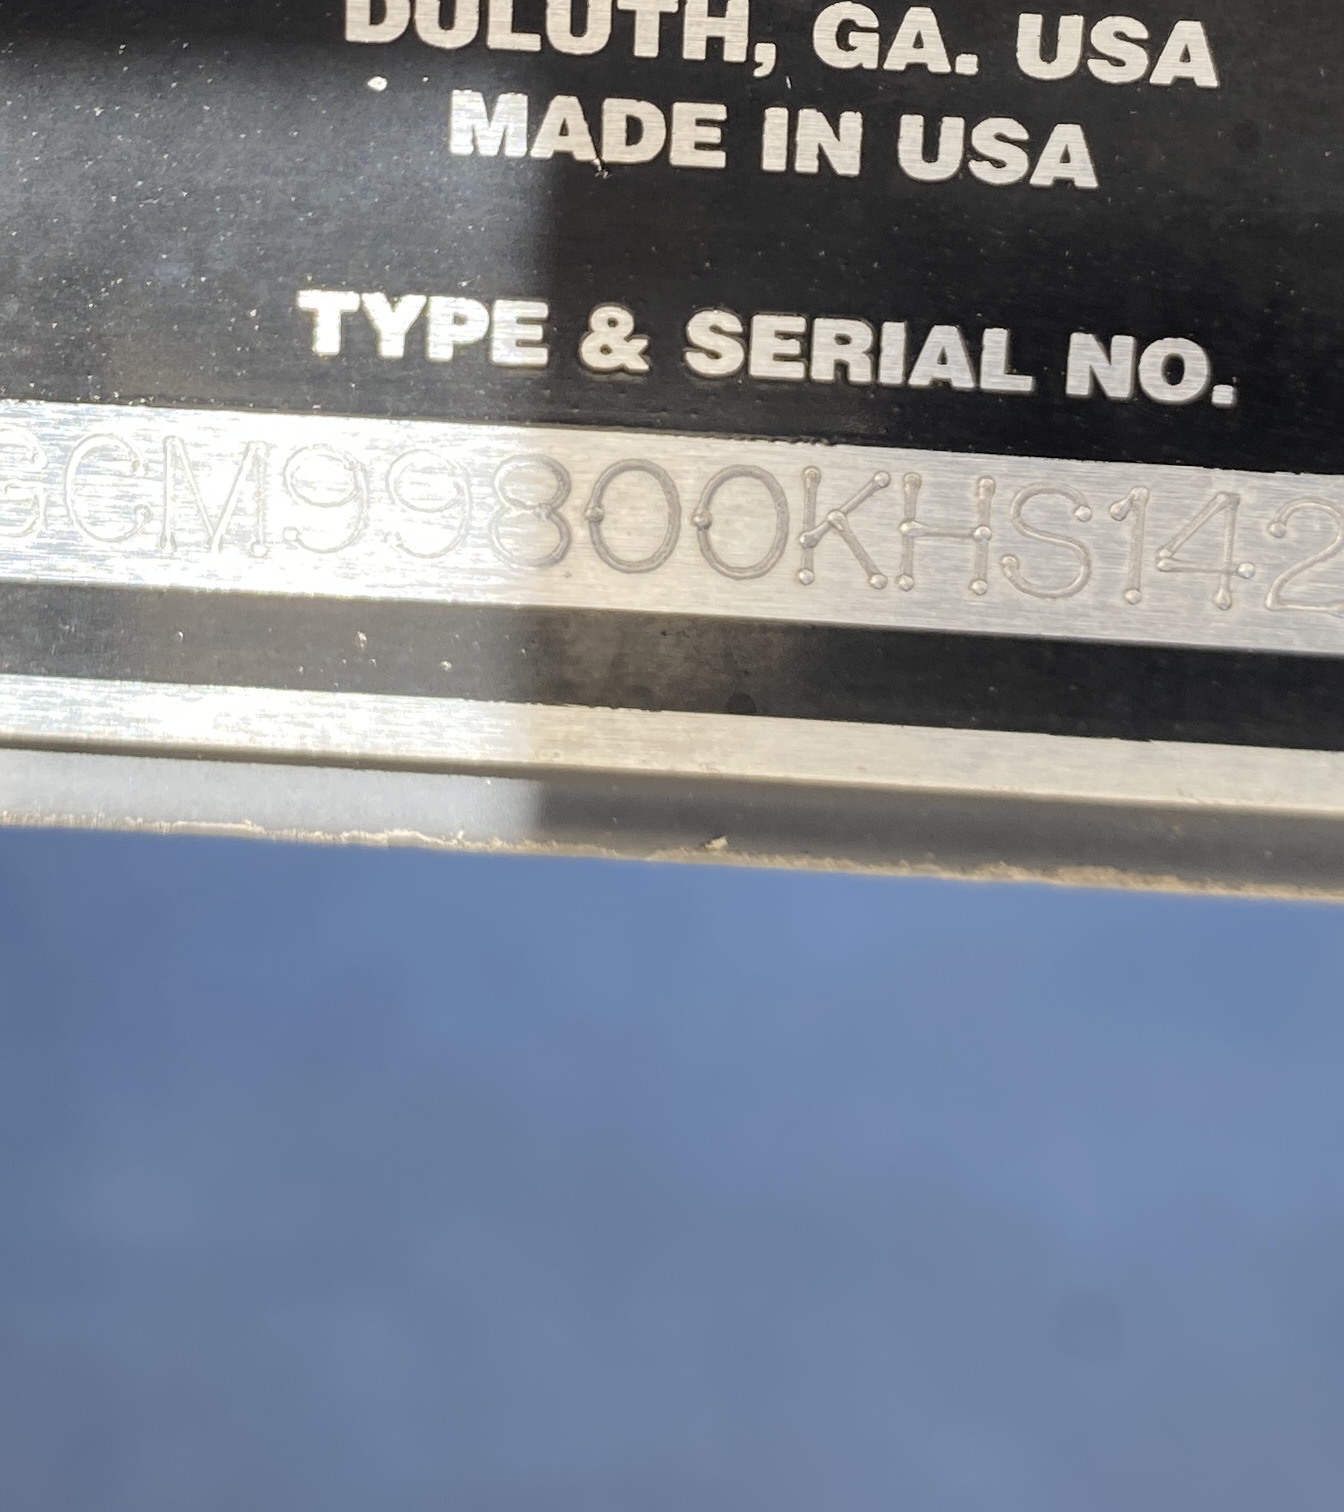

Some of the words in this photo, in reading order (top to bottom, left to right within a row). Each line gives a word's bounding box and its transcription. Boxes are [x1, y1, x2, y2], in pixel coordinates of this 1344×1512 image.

[812, 0, 979, 76] GA.
[1015, 13, 1220, 88] USA
[447, 89, 728, 169] MADE
[762, 107, 863, 176] IN
[897, 114, 1099, 188] USA
[296, 287, 549, 367] TYPE
[580, 305, 650, 372] &
[685, 309, 1034, 392] SERIAL
[1066, 332, 1237, 407] NO.
